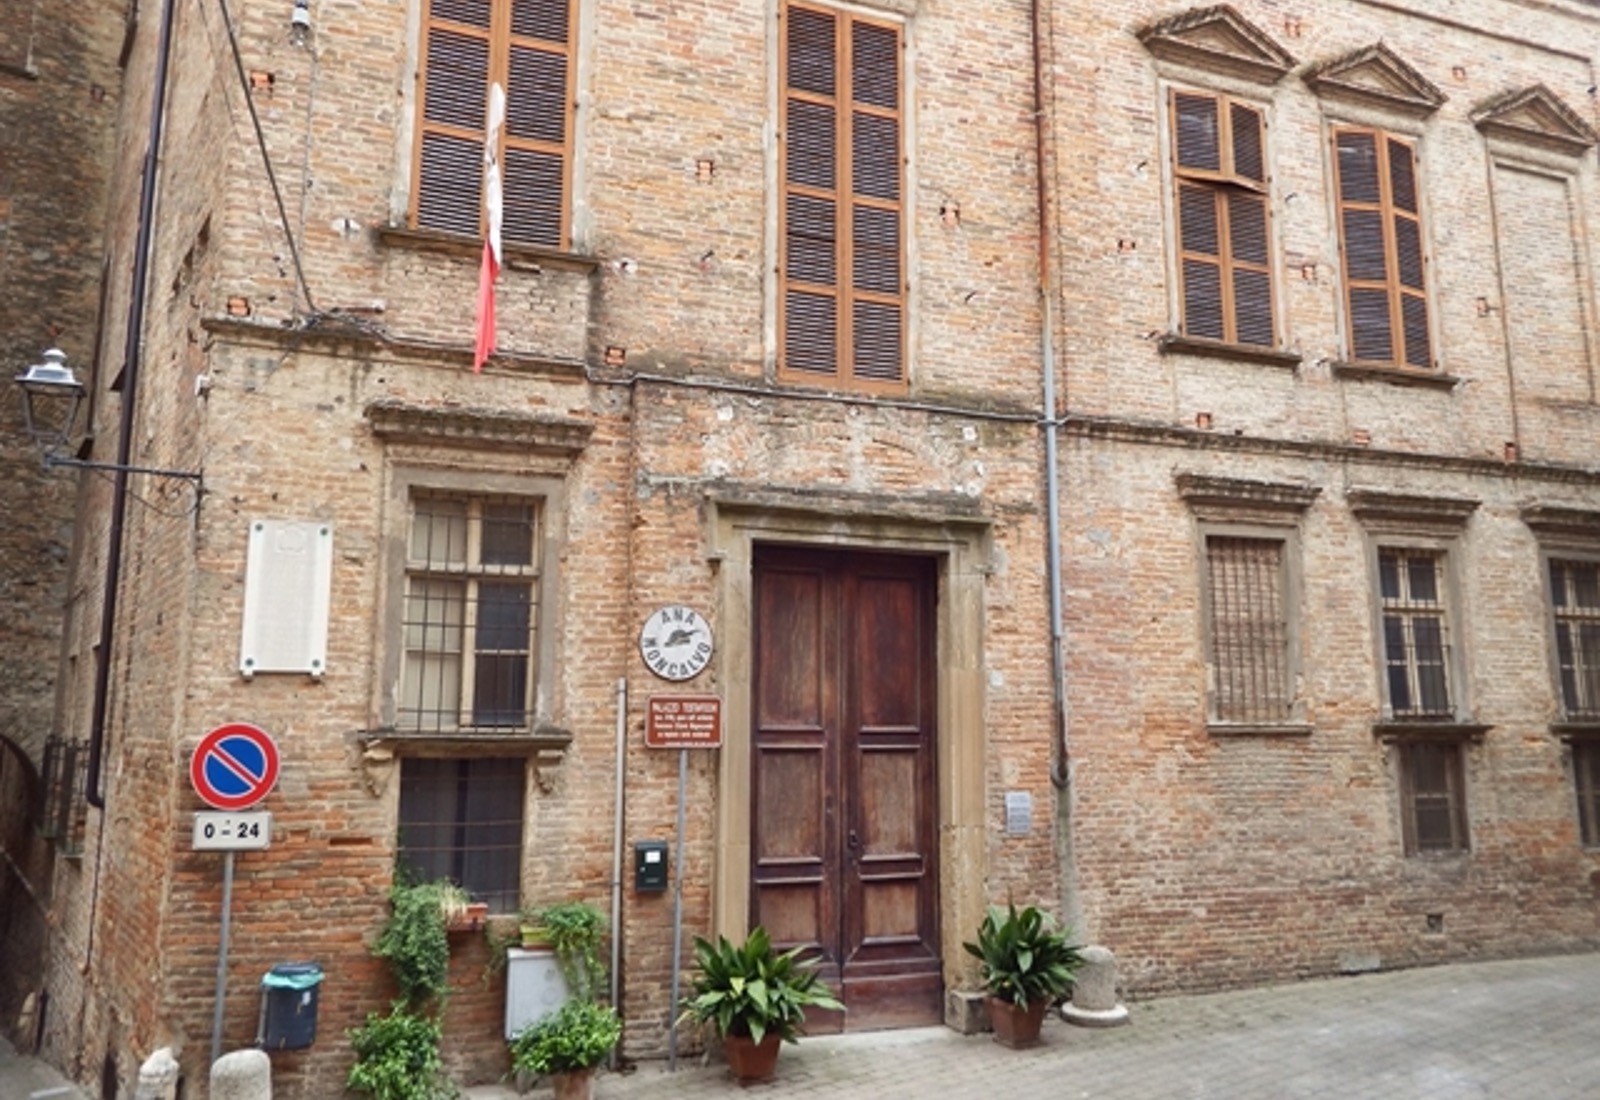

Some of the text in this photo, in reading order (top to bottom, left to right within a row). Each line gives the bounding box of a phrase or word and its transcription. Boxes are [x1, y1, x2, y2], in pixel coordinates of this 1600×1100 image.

[661, 607, 696, 625] ANA
[643, 637, 711, 677] MONCALVO
[204, 822, 215, 839] 0
[237, 822, 260, 838] 24
